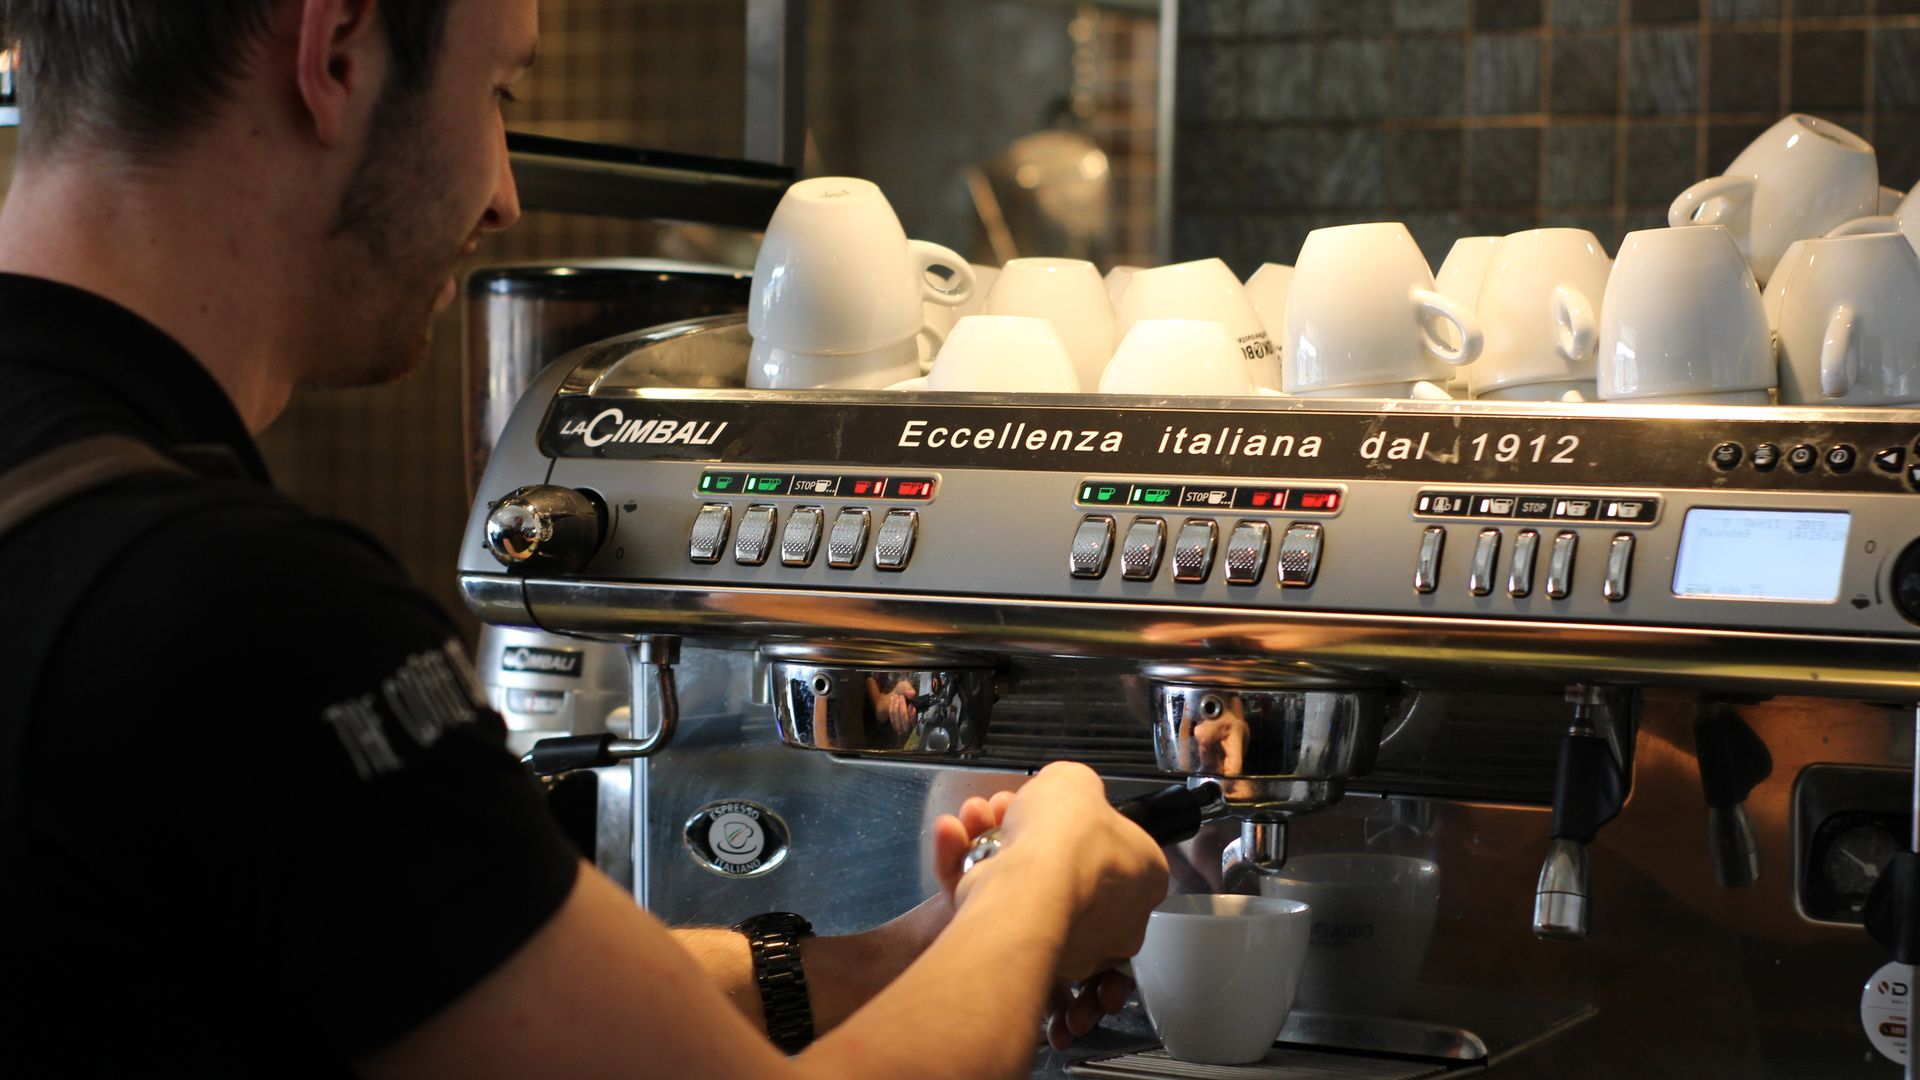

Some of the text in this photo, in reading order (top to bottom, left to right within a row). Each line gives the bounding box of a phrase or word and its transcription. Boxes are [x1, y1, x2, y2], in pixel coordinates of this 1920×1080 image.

[583, 408, 728, 447] CIMBALI
[898, 420, 1580, 463] Eccellenza italiana dal 1912
[795, 480, 816, 491] STOP
[1185, 491, 1209, 502] STOP
[1522, 502, 1548, 513] STOP
[709, 803, 760, 821] ESPRESSO
[714, 857, 761, 874] ITALIANO
